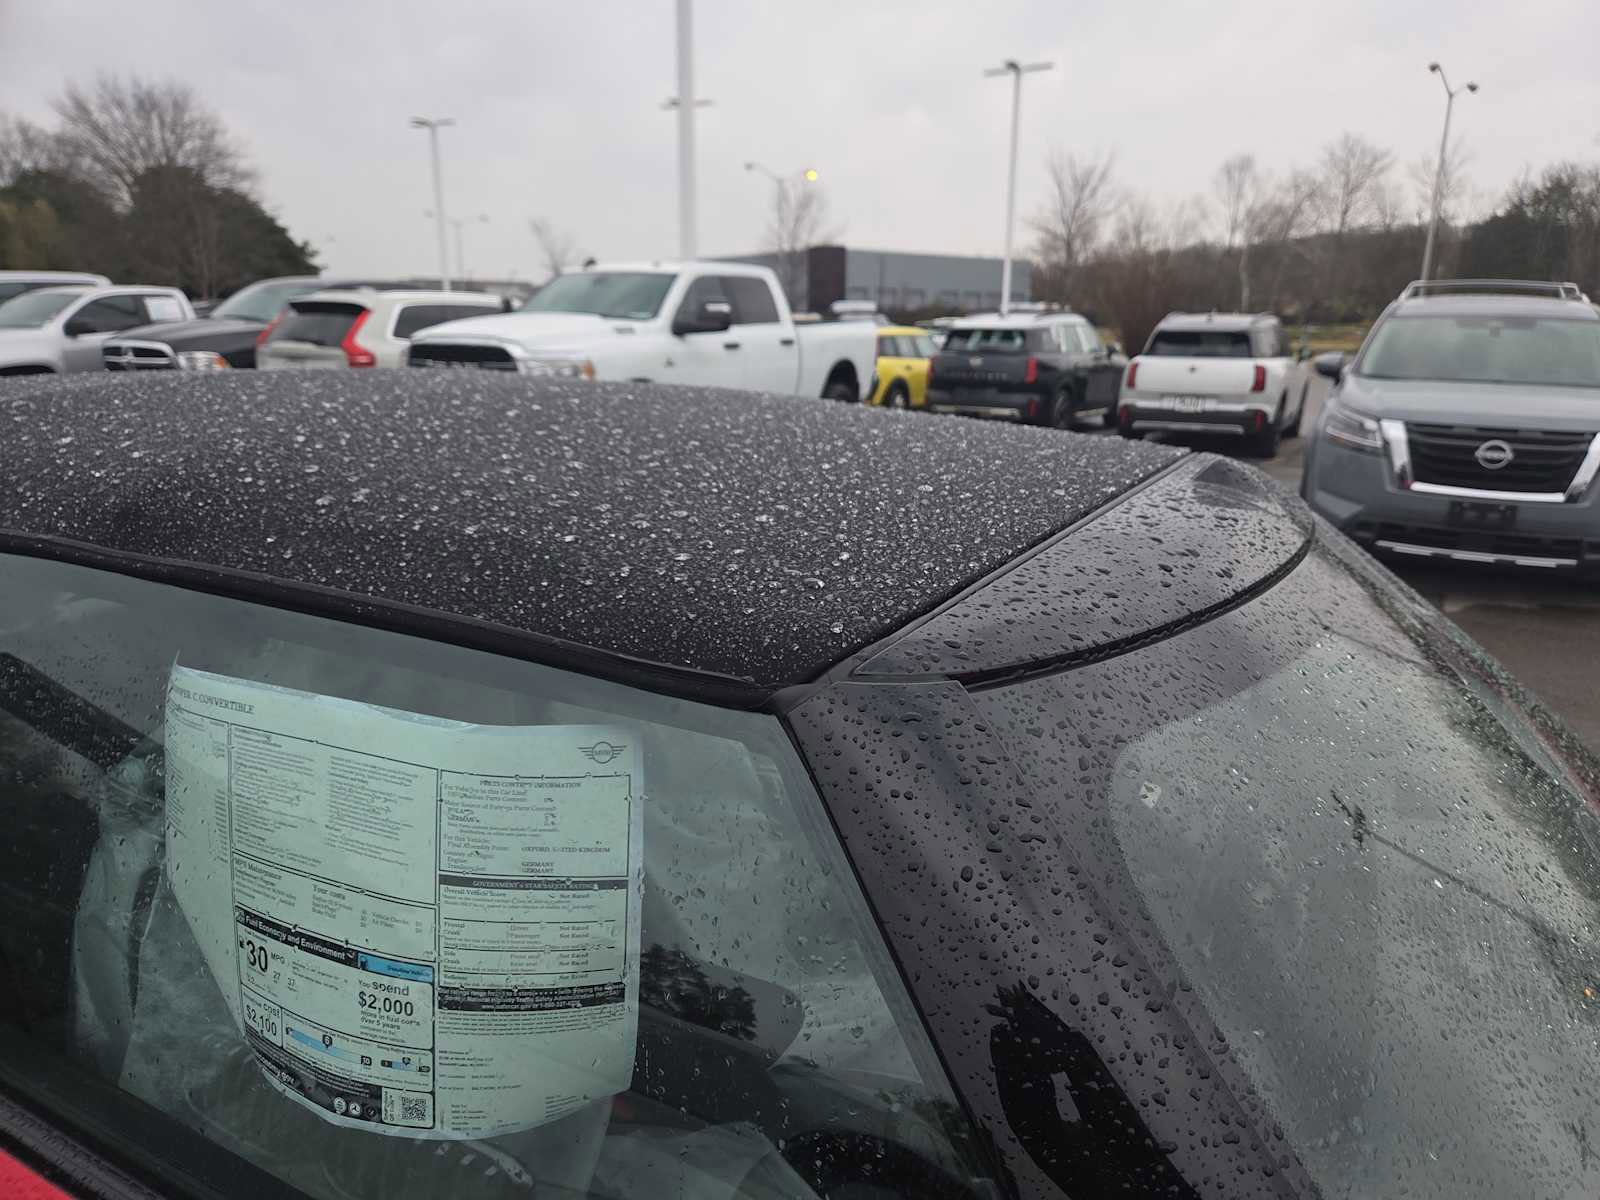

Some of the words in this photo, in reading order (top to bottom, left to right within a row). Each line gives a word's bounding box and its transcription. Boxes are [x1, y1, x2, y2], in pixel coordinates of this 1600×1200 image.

[199, 694, 255, 714] CONVERTIBLE
[246, 915, 259, 928] Fuel
[259, 921, 287, 941] Economy
[288, 934, 300, 945] and
[300, 938, 345, 960] Environment
[246, 940, 268, 973] 30
[358, 990, 413, 1017] $2,000
[372, 981, 409, 996] spend
[246, 1004, 277, 1037] $2,100
